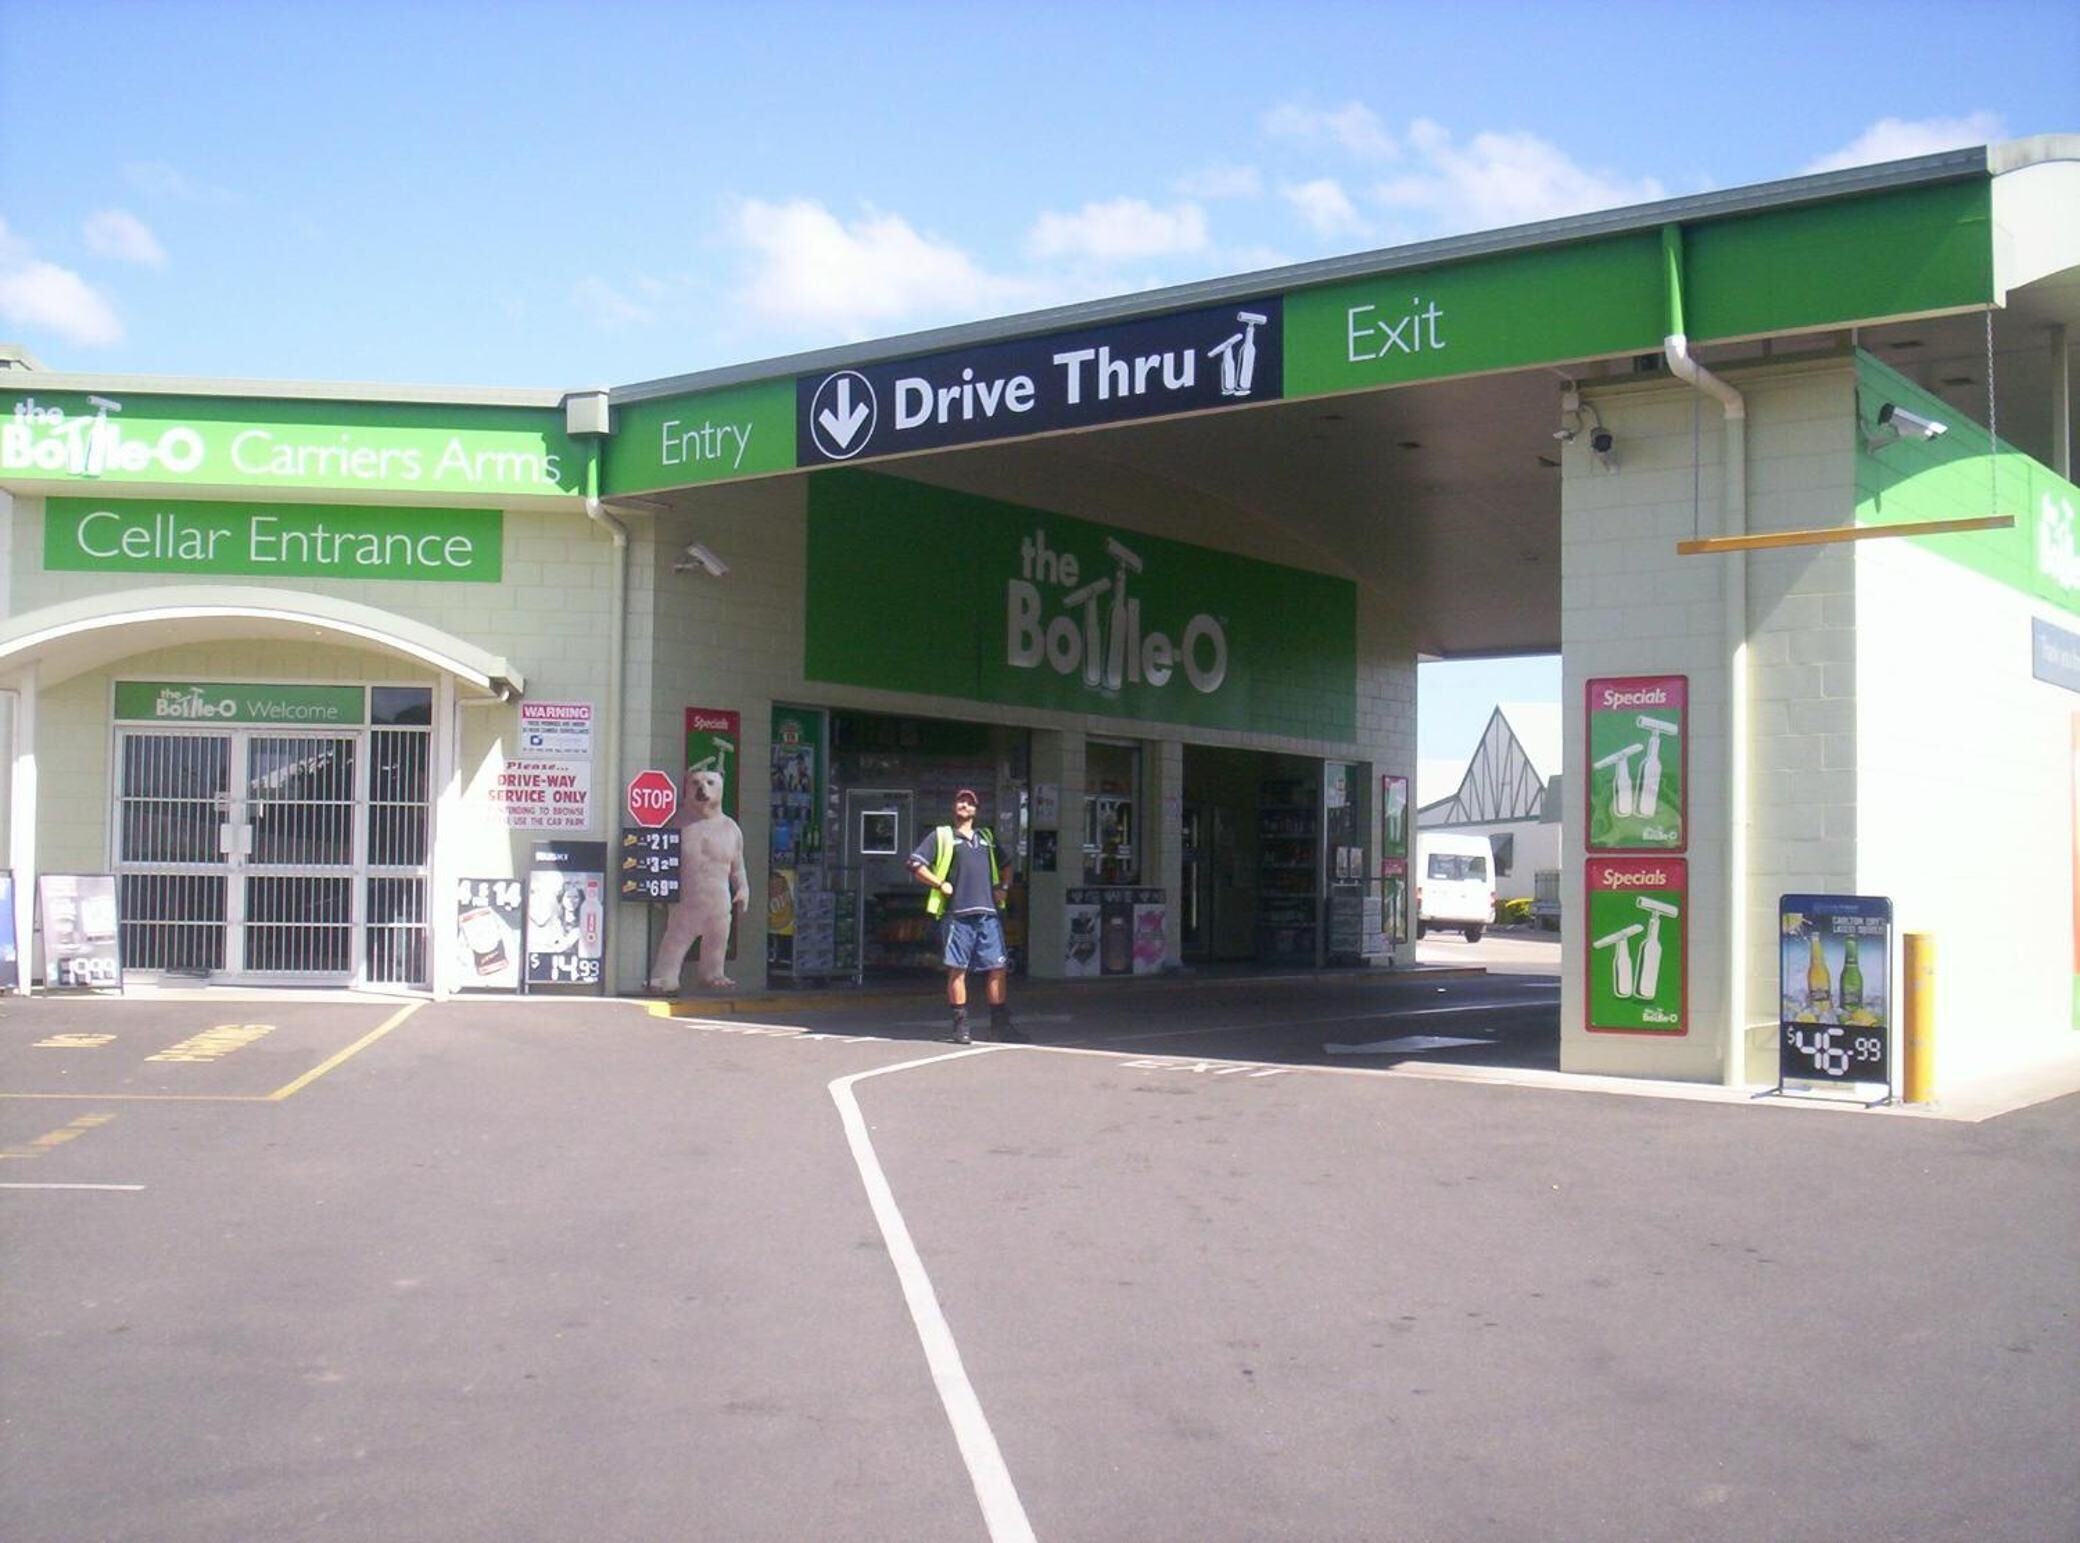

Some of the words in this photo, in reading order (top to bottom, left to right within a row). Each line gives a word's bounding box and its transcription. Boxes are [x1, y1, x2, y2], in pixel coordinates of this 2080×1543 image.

[1348, 297, 1446, 362] Exit
[894, 368, 1035, 430] Drive
[1054, 343, 1195, 405] Thru
[14, 398, 64, 424] the
[662, 420, 752, 469] Entry
[230, 429, 420, 477] Carriers
[432, 437, 561, 484] Arms
[77, 511, 231, 559] Cellar
[250, 516, 473, 567] Entrance
[1021, 529, 1079, 587] the
[160, 689, 182, 699] the
[1603, 688, 1666, 709] Specials
[246, 701, 338, 719] Welcome
[524, 706, 589, 718] WARNING
[497, 774, 577, 788] DRIVE-WAY
[488, 790, 545, 803] SERVICE
[553, 791, 587, 803] ONLY
[632, 788, 673, 808] STOP
[531, 817, 543, 826] THE
[565, 817, 585, 826] PARK
[540, 807, 549, 816] TO
[1603, 869, 1666, 889] Specials
[1118, 1059, 1292, 1078] EXIT
